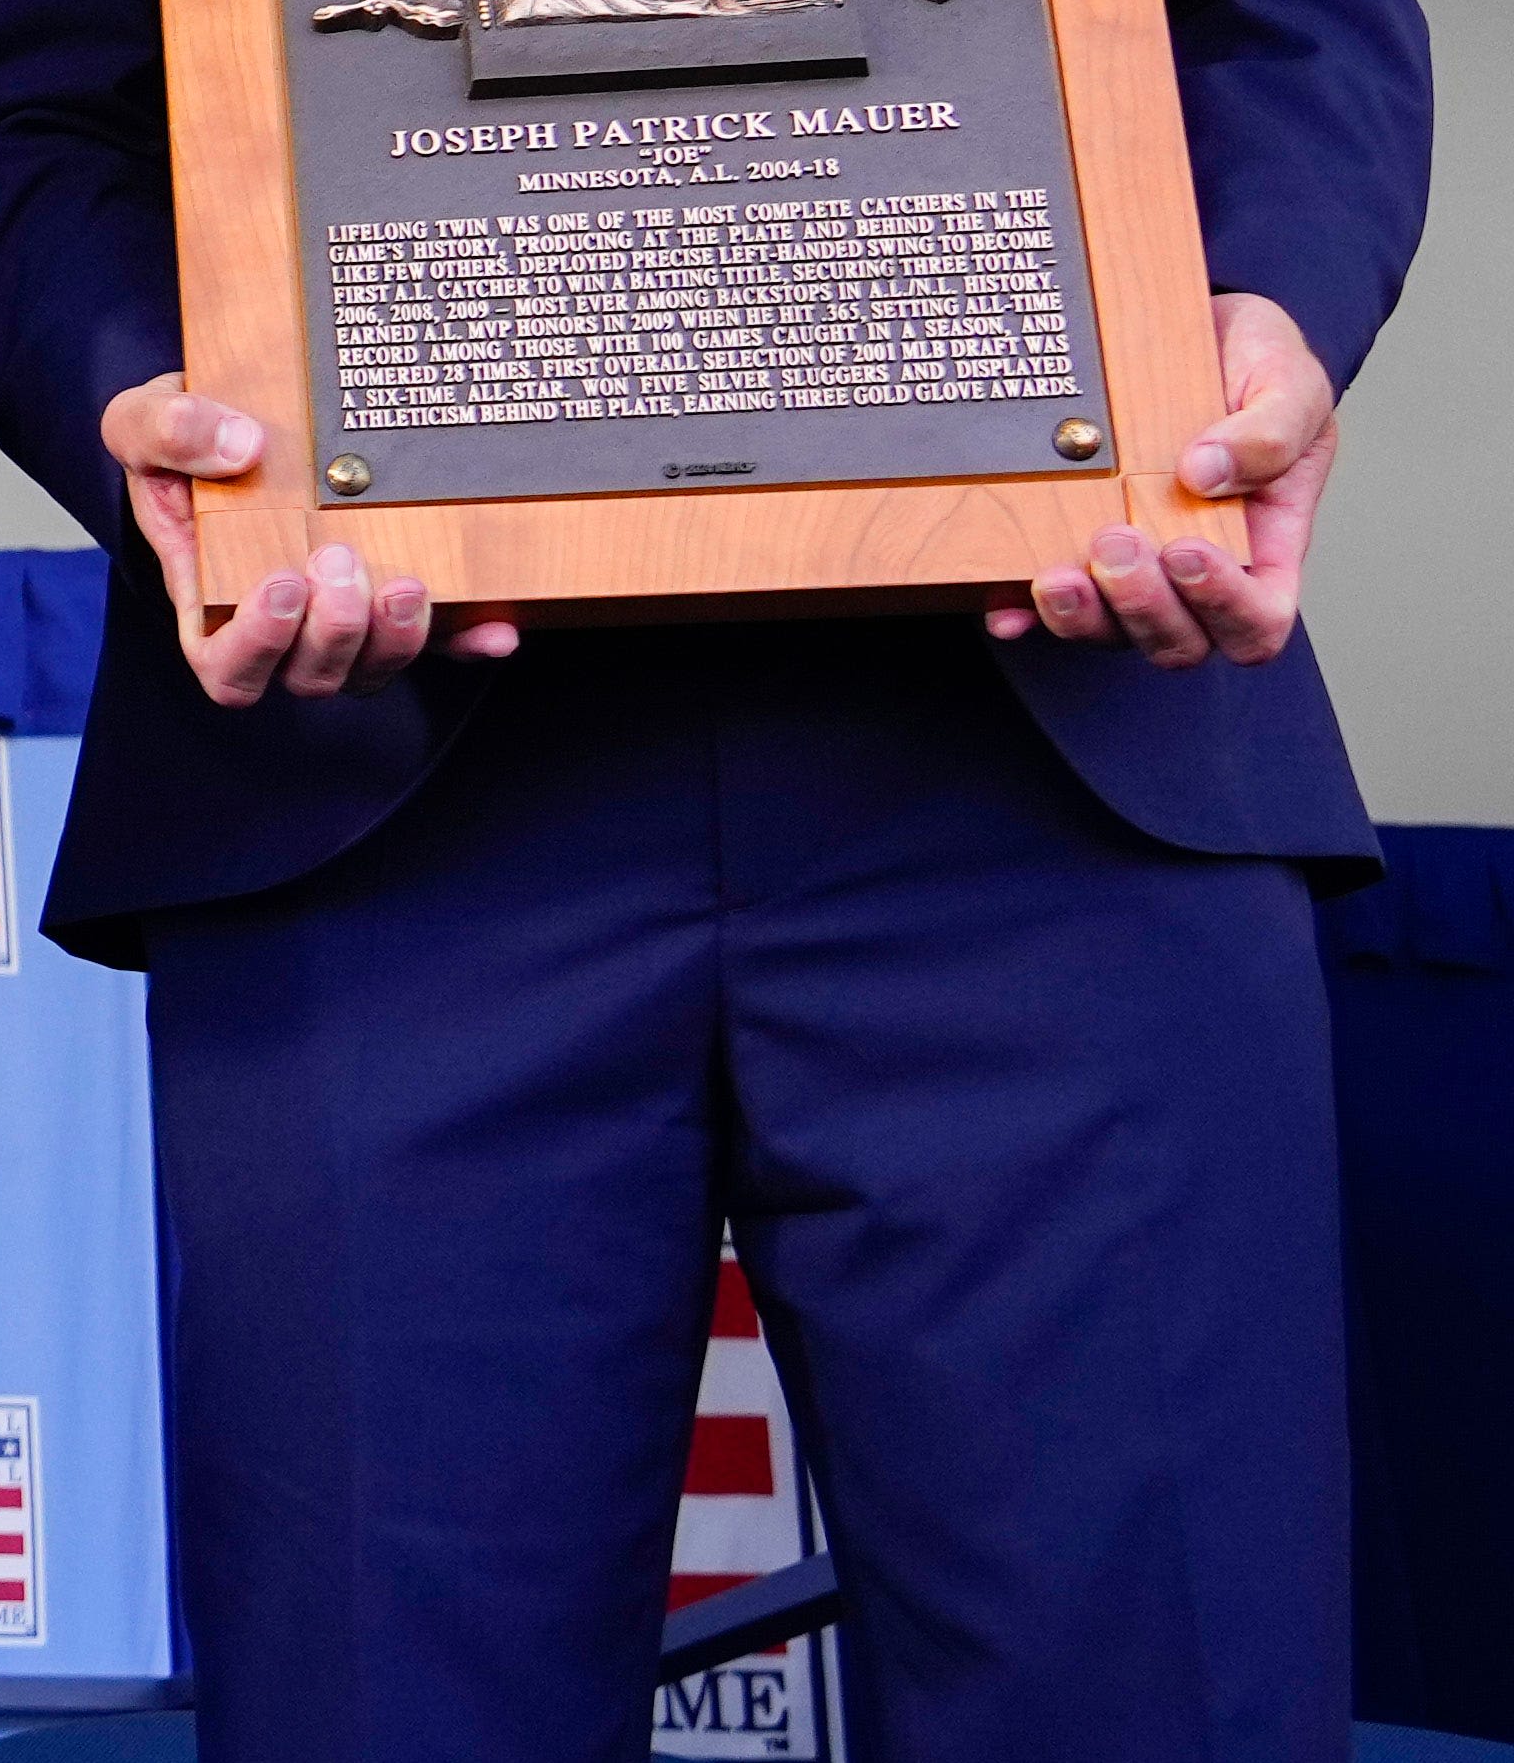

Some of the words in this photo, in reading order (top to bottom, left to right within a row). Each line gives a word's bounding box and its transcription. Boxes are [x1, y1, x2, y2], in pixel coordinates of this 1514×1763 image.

[390, 122, 558, 156] JOSEPH
[572, 110, 776, 147] PATRICK
[789, 101, 960, 135] MAUER
[517, 167, 682, 192] MINNESOTA,
[688, 163, 740, 183] A.L.
[746, 157, 840, 180] 2004-18
[327, 220, 428, 242] LIFELONG
[434, 217, 488, 237] TWIN
[496, 214, 540, 234] WAS
[547, 212, 590, 232] ONE
[597, 210, 625, 229] OF
[632, 208, 675, 228] THE
[681, 204, 736, 225] MOST
[744, 198, 852, 222] COMPLETE
[860, 193, 967, 216] CATCHERS
[973, 191, 998, 210] IN
[1004, 188, 1048, 208] THE
[343, 404, 476, 429] ATHLETICISM
[480, 401, 558, 422] BEHIND
[560, 398, 603, 418] THE
[606, 395, 679, 417] PLATE,
[682, 390, 776, 413] EARNING
[779, 386, 849, 408] THREE
[853, 384, 911, 404] GOLD
[915, 380, 984, 401] GLOVE
[990, 376, 1083, 398] AWARDS.
[656, 1669, 789, 1732] ME
